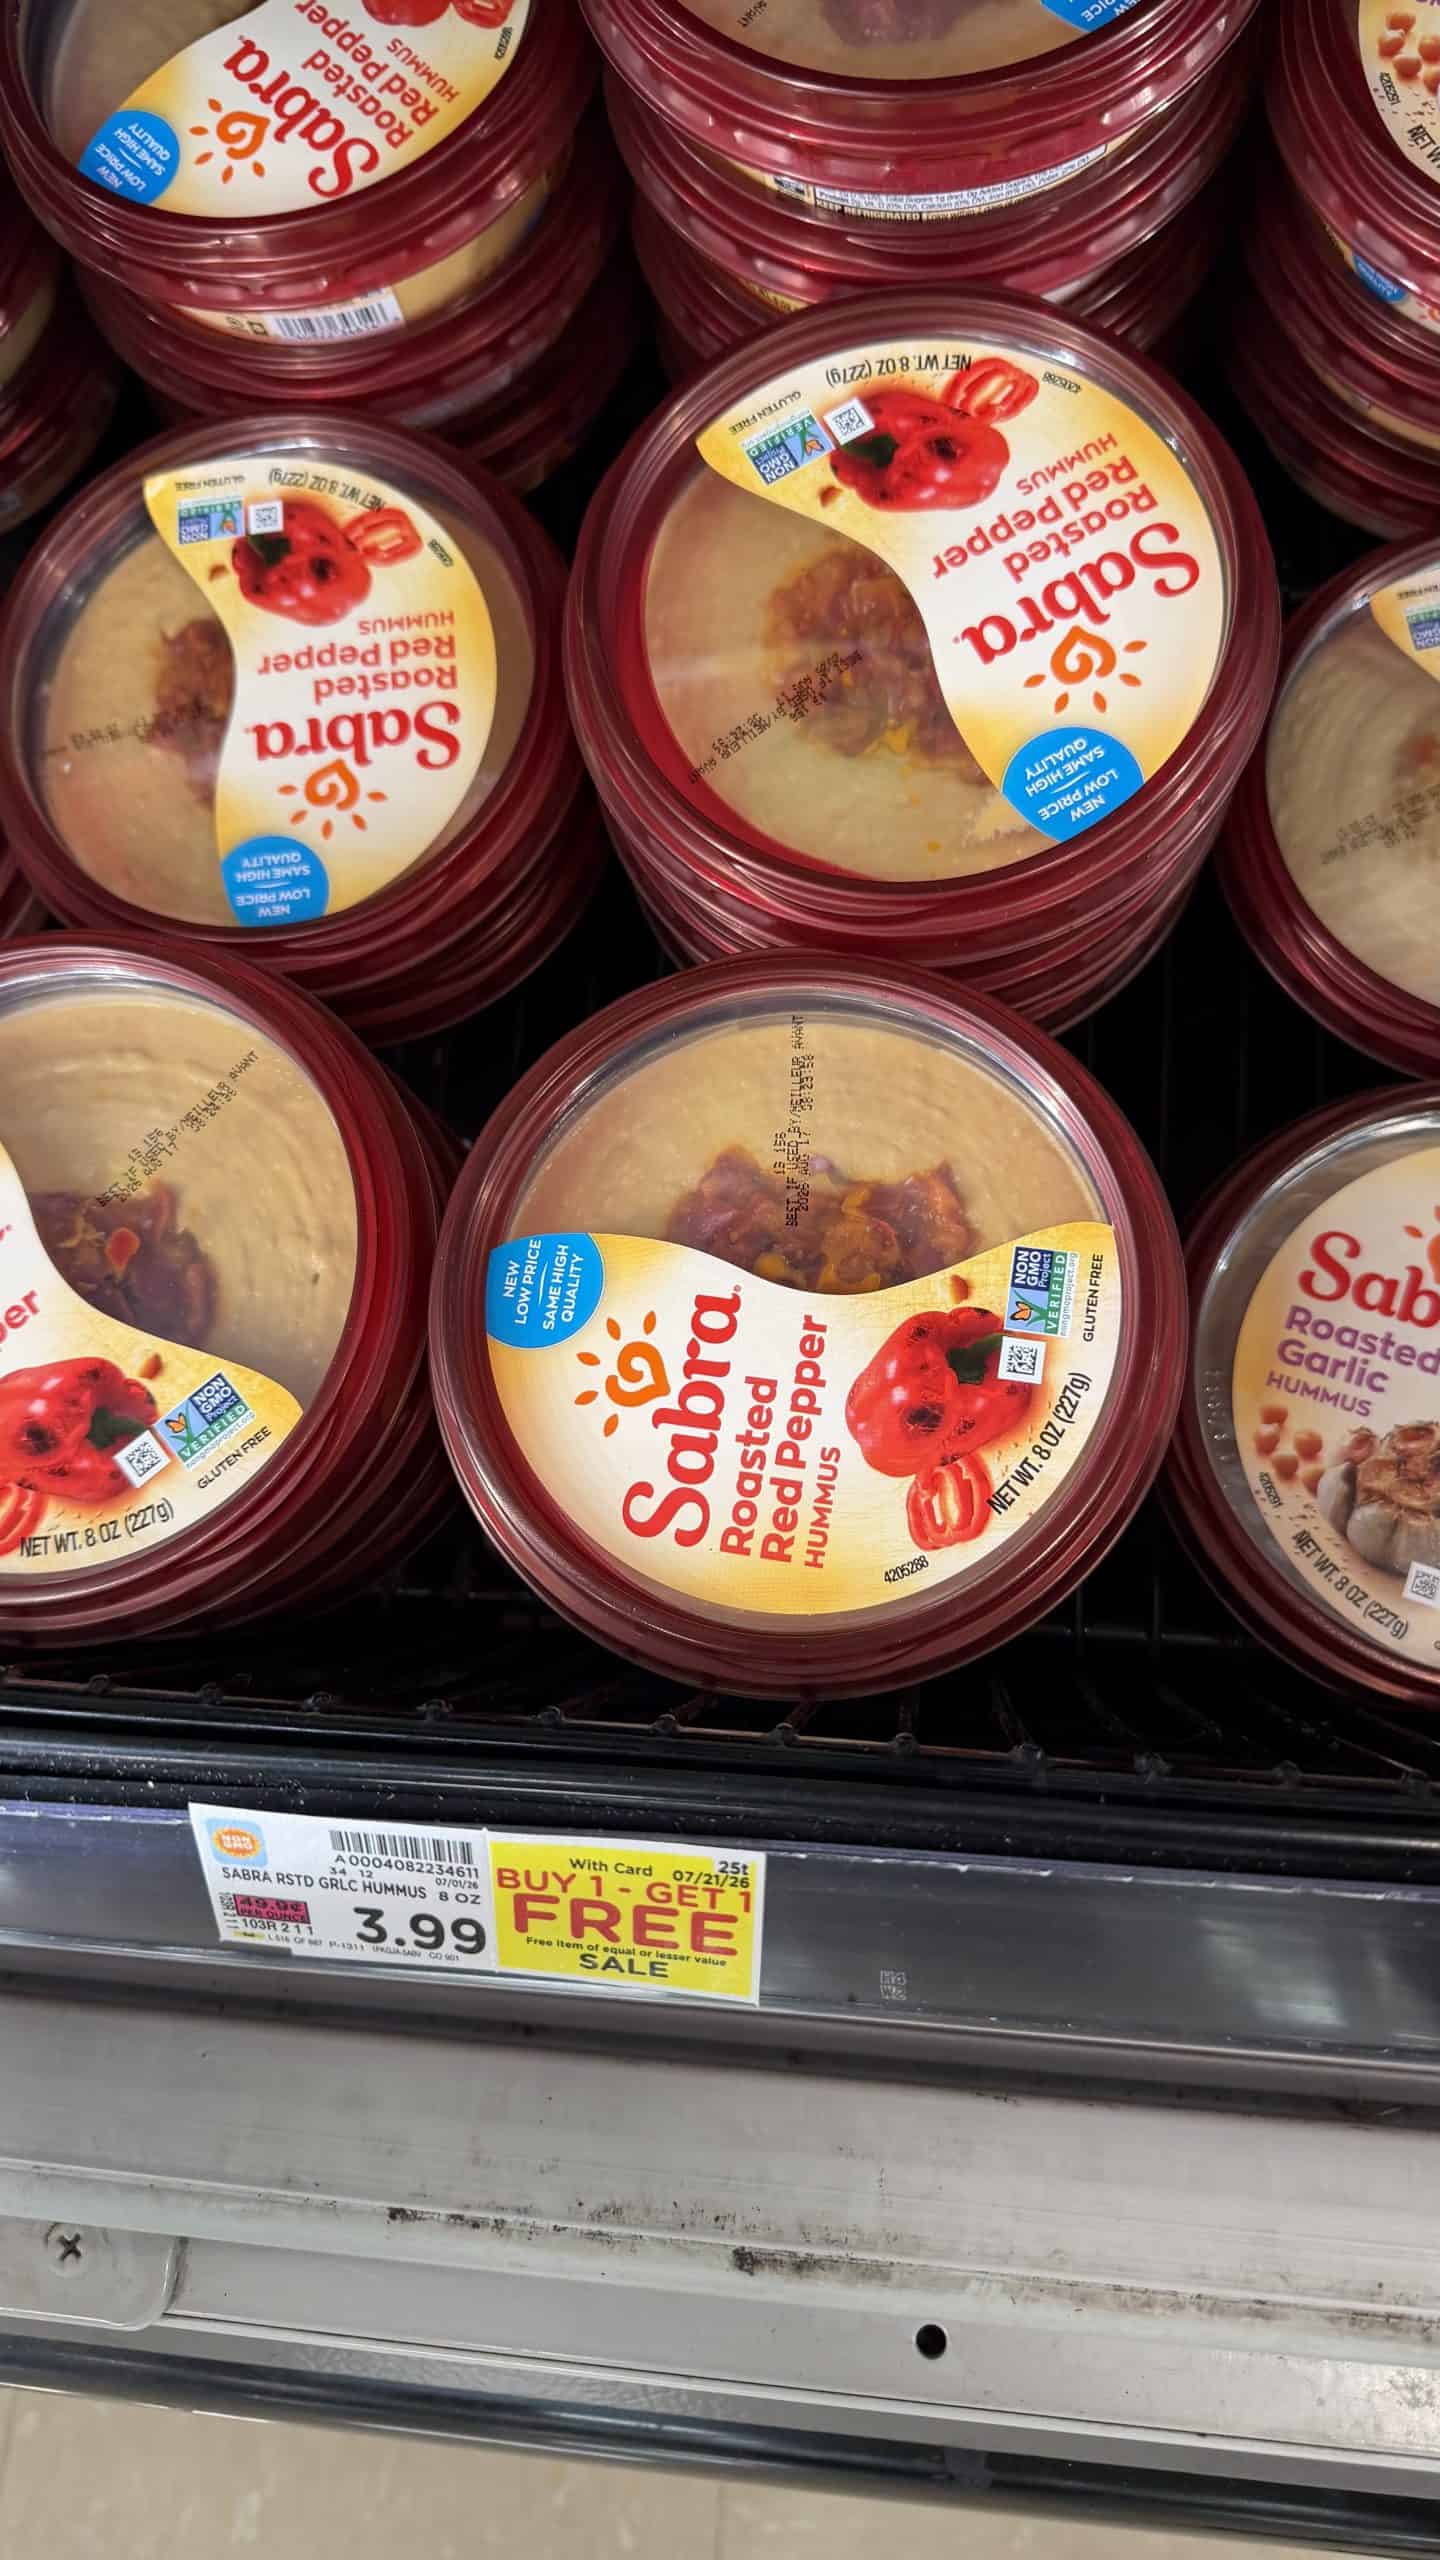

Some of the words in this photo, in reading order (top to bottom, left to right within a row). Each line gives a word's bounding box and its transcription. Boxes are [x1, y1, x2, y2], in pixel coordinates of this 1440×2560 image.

[295, 0, 389, 82] Pepper
[386, 37, 461, 103] HUMMUS
[223, 38, 379, 198] Sabra
[301, 49, 414, 149] Roasted
[378, 72, 439, 127] Red
[128, 123, 170, 161] QUALITY
[825, 361, 873, 390] (227g)
[876, 360, 897, 376] OZ
[900, 358, 910, 373] 8
[942, 355, 973, 372] NET
[757, 390, 802, 420] GLUTEN
[729, 415, 758, 436] FREE
[748, 418, 812, 457] VERIFIED
[760, 453, 790, 475] GMO
[766, 461, 796, 483] NON
[1016, 432, 1119, 496] HUMMUS
[309, 475, 328, 492] OZ
[327, 478, 338, 494] 8
[1060, 455, 1139, 513] Red
[932, 495, 1064, 580] Pepper
[1002, 483, 1159, 584] Roasted
[961, 521, 1200, 665] Sabra
[359, 610, 456, 635] HUMMUS
[257, 641, 381, 676] Pepper
[391, 635, 457, 662] Red
[313, 664, 458, 704] Roasted
[253, 700, 462, 771] Sabra
[1025, 737, 1088, 781] QUALITY
[1062, 745, 1105, 776] SAME
[1025, 769, 1064, 798] HIGH
[1083, 768, 1118, 796] LOW
[1038, 789, 1083, 821] PRICE
[1070, 795, 1106, 822] NEW
[235, 869, 271, 884] HIGH
[242, 851, 302, 868] QUALITY
[271, 864, 311, 880] SAME
[235, 892, 277, 907] PRICE
[257, 904, 291, 918] NEW
[280, 887, 311, 902] LOW
[503, 1260, 521, 1299] NEW
[514, 1290, 532, 1325] LOW
[523, 1238, 543, 1289] PRICE
[550, 1244, 570, 1283] HIGH
[1015, 1250, 1029, 1285] NON
[1026, 1250, 1041, 1288] GMO
[1038, 1251, 1053, 1288] Project
[1091, 1253, 1104, 1290] FREE
[542, 1284, 563, 1331] SAME
[561, 1254, 584, 1323] QUALITY
[1046, 1253, 1067, 1333] VERIFIED
[1083, 1291, 1100, 1343] GLUTEN
[1284, 1304, 1440, 1376] Roasted
[1277, 1338, 1389, 1393] Garlic
[192, 1377, 224, 1405] NON
[200, 1386, 232, 1414] GMO
[774, 1314, 828, 1470] Pepper
[1265, 1370, 1373, 1417] HUMMUS
[180, 1404, 248, 1458] VERIFIED
[622, 1290, 742, 1548] Sabra
[197, 1448, 242, 1490] GLUTEN
[242, 1426, 272, 1454] FREE
[985, 1479, 1020, 1516] NET
[1011, 1456, 1043, 1496] WT.
[1031, 1443, 1051, 1462] 8
[1041, 1420, 1066, 1450] OZ
[1060, 1371, 1092, 1425] (227g)
[719, 1376, 778, 1557] Roasted
[19, 1535, 51, 1557] NET
[54, 1531, 82, 1553] WT.
[85, 1529, 96, 1547] 8
[99, 1521, 121, 1543] OZ
[125, 1497, 174, 1539] (227g)
[760, 1477, 804, 1563] Red
[804, 1447, 841, 1569] HUMMUS
[883, 1554, 929, 1584] 4205288
[1293, 1529, 1323, 1559] NET
[1313, 1549, 1340, 1583] WT.
[1333, 1575, 1350, 1591] 8
[1345, 1585, 1369, 1608] OZ
[1361, 1599, 1409, 1640] (227g)
[222, 1867, 272, 1883] SABRA
[276, 1872, 314, 1888] RSTD
[318, 1876, 358, 1893] GRLC
[362, 1881, 427, 1900] HUMMUS
[438, 1891, 449, 1902] 8
[454, 1892, 481, 1905] OZ
[329, 1867, 347, 1876] 34
[359, 1869, 373, 1878] 12
[435, 1878, 479, 1890] 07/01/26
[569, 1858, 608, 1873] With
[614, 1862, 653, 1877] Card
[672, 1869, 750, 1888] 07/21/26
[718, 1861, 749, 1876] 25t
[496, 1867, 577, 1894] BUY
[589, 1876, 603, 1897] 1
[646, 1882, 726, 1910] GET
[738, 1891, 751, 1913] 1
[242, 1919, 277, 1931] 103R
[280, 1923, 290, 1933] 2
[294, 1924, 301, 1934] 1
[307, 1926, 314, 1936] 1
[354, 1906, 487, 1955] 3.99
[513, 1892, 738, 1957] FREE
[526, 1936, 553, 1948] Free
[556, 1939, 584, 1951] item
[587, 1941, 599, 1952] of
[602, 1944, 636, 1958] equal
[639, 1949, 652, 1958] or
[655, 1951, 690, 1963] lesser
[694, 1955, 727, 1967] value
[579, 1953, 670, 1979] SALE
